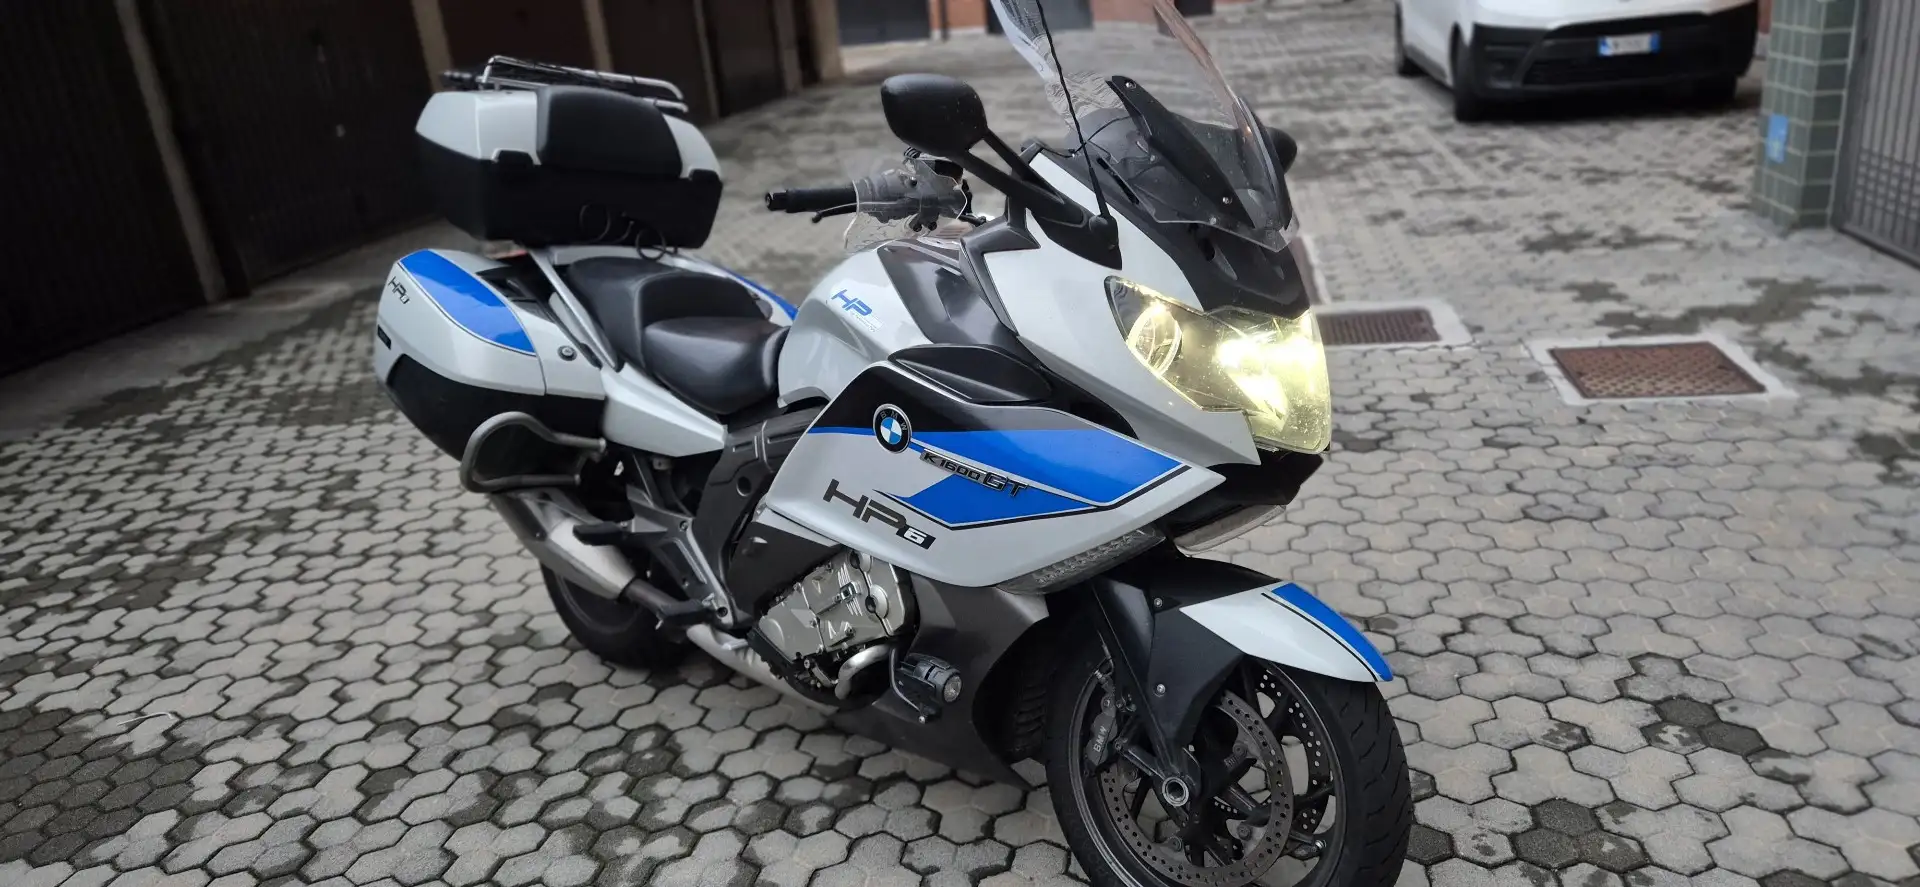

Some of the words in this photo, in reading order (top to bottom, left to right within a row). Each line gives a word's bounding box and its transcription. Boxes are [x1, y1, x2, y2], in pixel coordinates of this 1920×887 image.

[831, 289, 872, 316] HP
[880, 410, 908, 431] BMW
[1094, 725, 1107, 753] BMW
